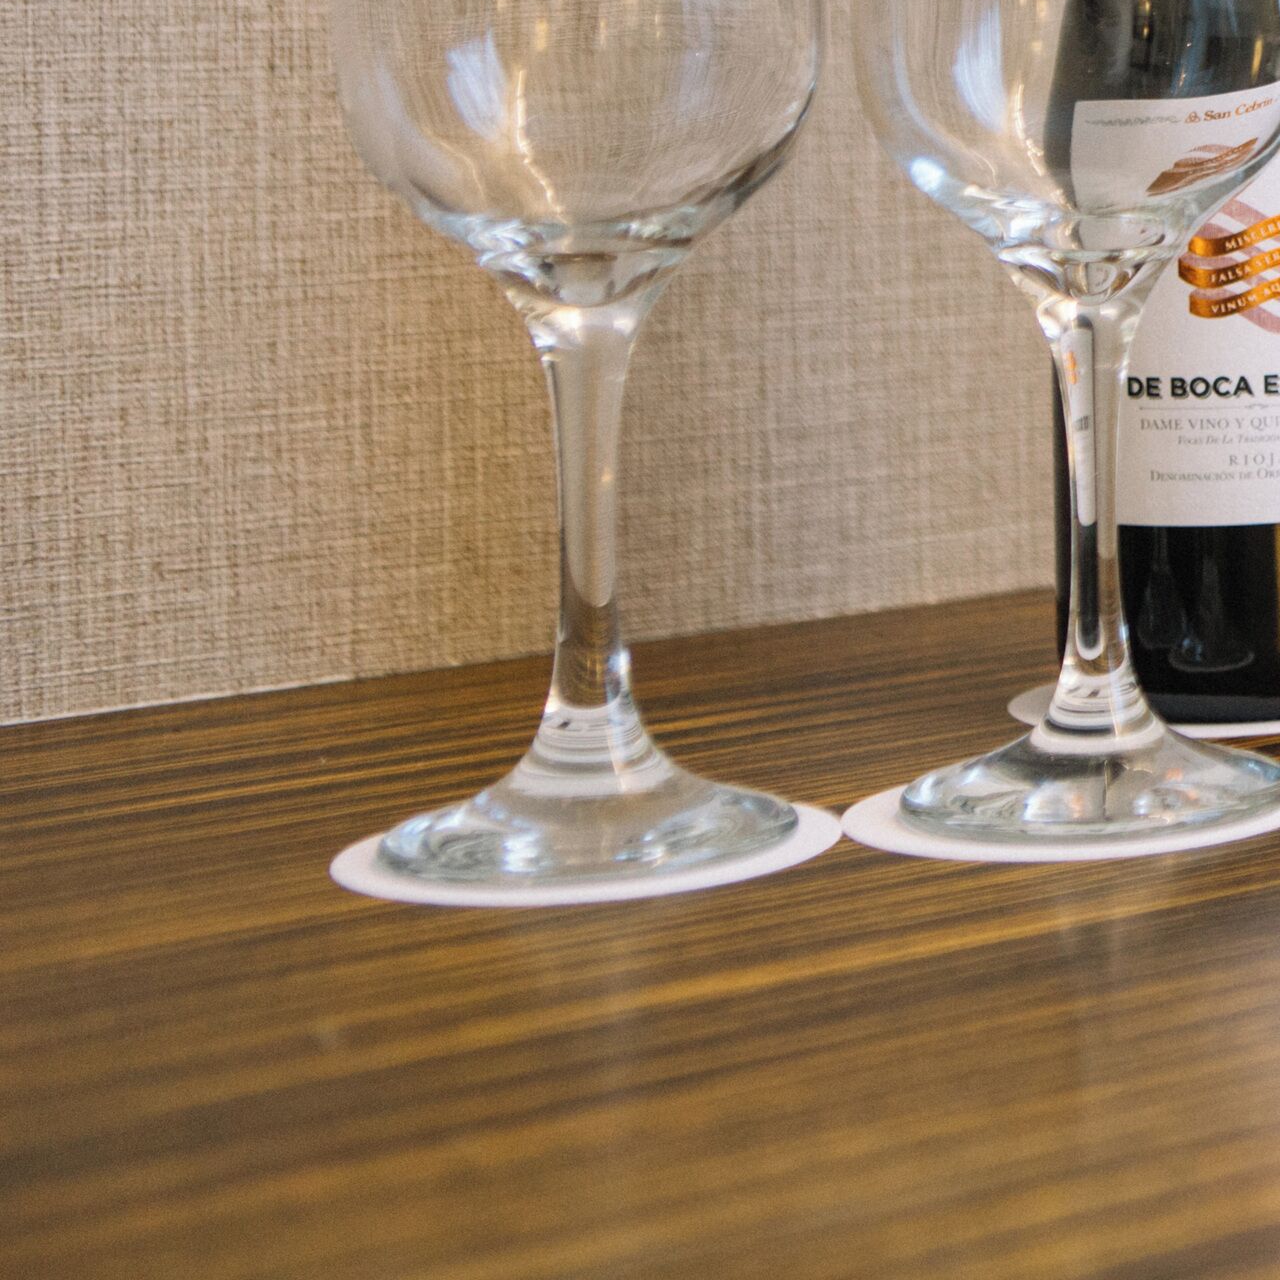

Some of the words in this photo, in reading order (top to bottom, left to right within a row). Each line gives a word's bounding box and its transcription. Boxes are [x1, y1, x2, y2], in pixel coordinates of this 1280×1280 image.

[1203, 109, 1232, 122] San
[1210, 264, 1253, 284] FALSA
[1211, 294, 1257, 314] VINUM
[1126, 376, 1162, 398] DE
[1170, 375, 1253, 399] BOCA
[1140, 418, 1183, 431] DAME
[1187, 418, 1230, 431] VINO
[1235, 417, 1245, 430] Y
